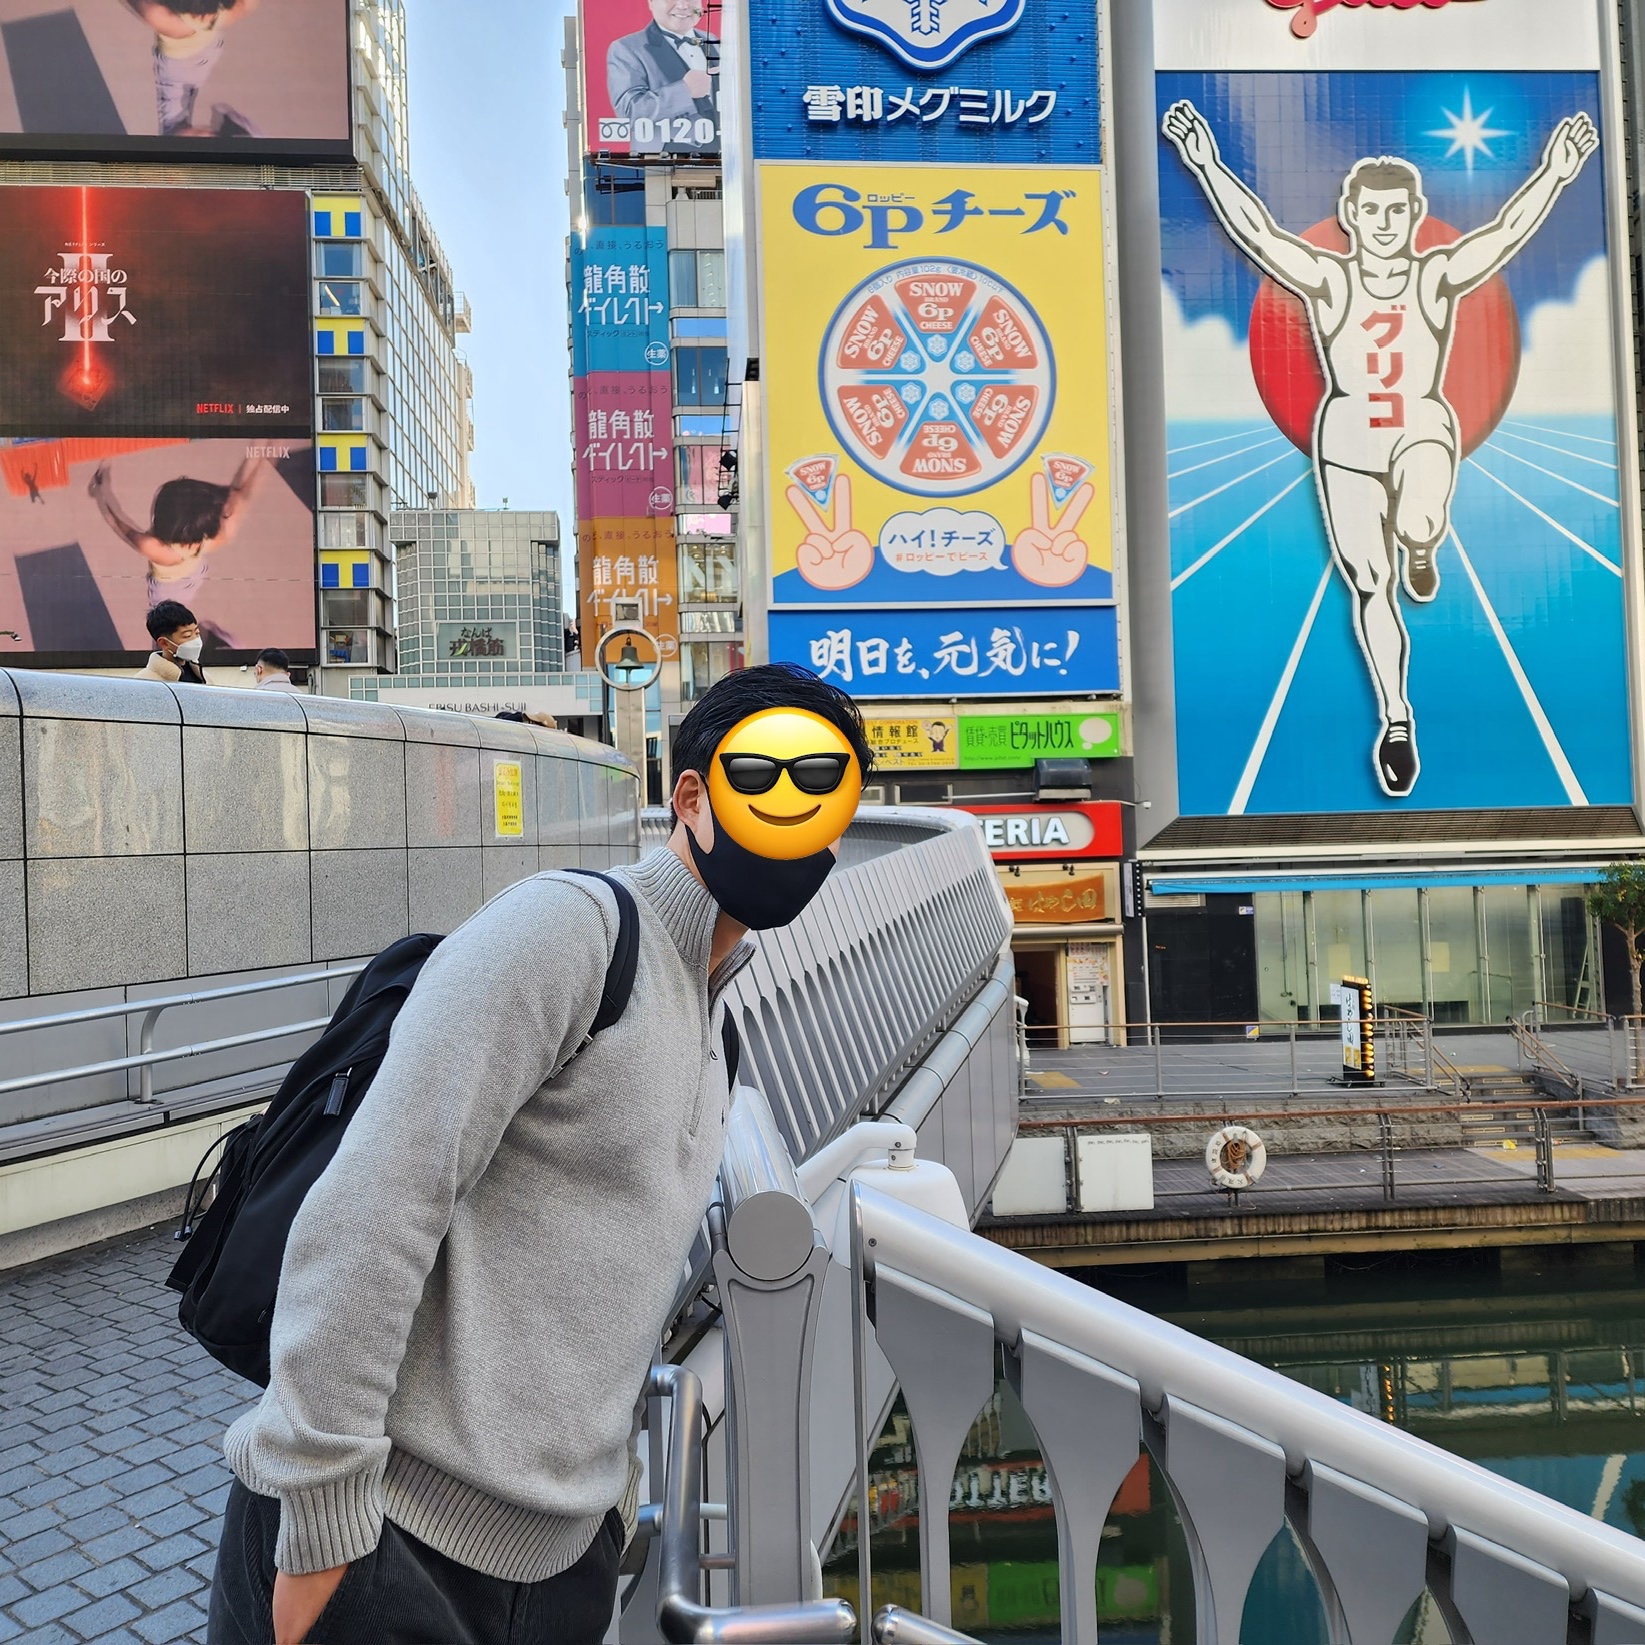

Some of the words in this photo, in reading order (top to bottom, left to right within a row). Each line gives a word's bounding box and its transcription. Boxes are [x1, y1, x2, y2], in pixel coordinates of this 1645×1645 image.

[803, 85, 1057, 124] 雪印メグミルク
[867, 193, 915, 203] ロッピー
[44, 268, 127, 284] 今際の国の
[583, 264, 651, 294] 龍角散
[909, 282, 964, 297] SNOW
[34, 286, 137, 326] アリス
[844, 305, 880, 359] SNOW
[920, 321, 953, 330] CHEESE
[993, 309, 1033, 359] SNOW
[647, 349, 668, 359] 生薬
[882, 336, 904, 367] CHEESE
[971, 336, 993, 367] CHEESE
[1360, 305, 1406, 428] グリコ
[196, 404, 234, 414] NETFLIX
[246, 404, 290, 414] 独占配信中
[885, 388, 906, 419] CHEESE
[971, 388, 993, 419] CHEESE
[588, 409, 655, 439] 龍角散
[843, 396, 883, 447] SNOW
[923, 425, 957, 433] CHEESE
[997, 396, 1032, 448] SNOW
[246, 446, 290, 459] NETFLIX
[582, 442, 668, 471] ダイレクト
[912, 458, 967, 473] SNOW
[1053, 460, 1081, 473] SNOW
[800, 461, 826, 476] SNOW
[593, 555, 659, 586] 龍角散
[460, 626, 493, 639] なんば
[872, 725, 918, 738] 情報館
[1010, 720, 1074, 749] ピタットハウス
[979, 817, 1070, 847] ERIA
